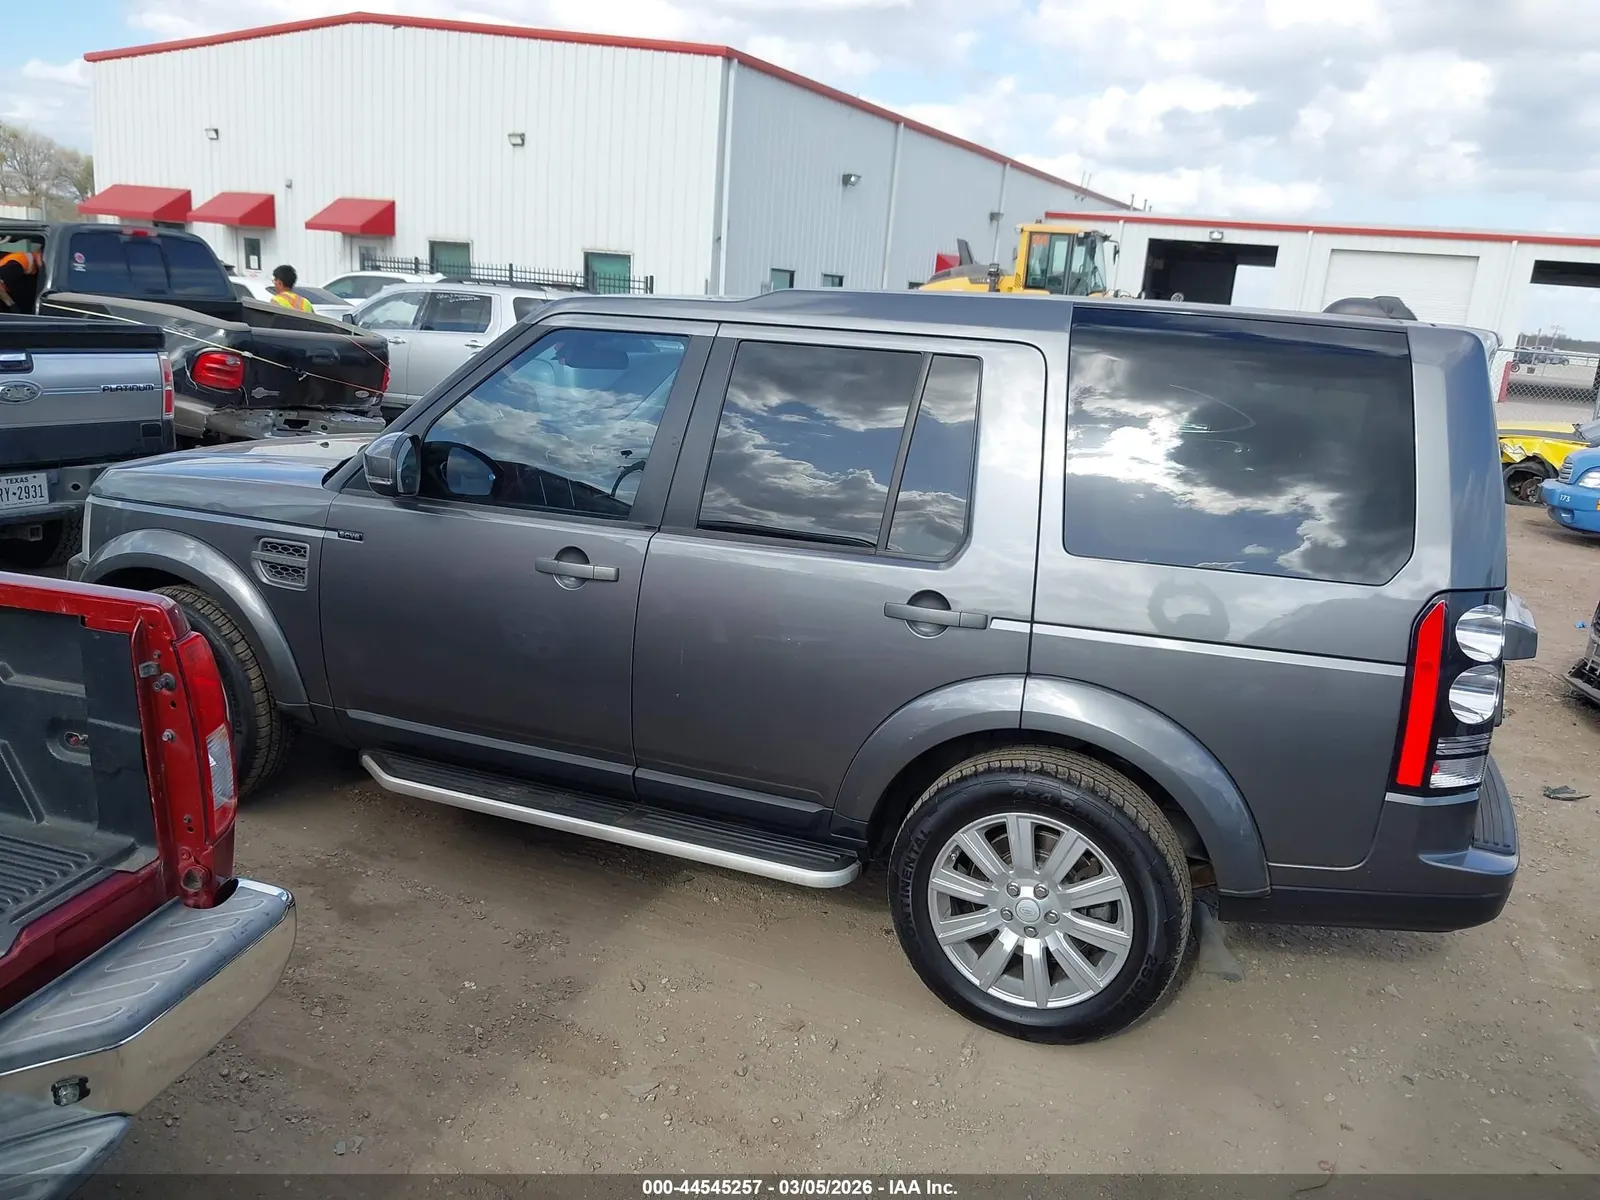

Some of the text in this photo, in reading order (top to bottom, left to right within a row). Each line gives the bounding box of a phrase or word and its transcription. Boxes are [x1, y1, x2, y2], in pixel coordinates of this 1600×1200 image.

[101, 383, 155, 393] PLATINUM
[5, 476, 29, 485] TEXAS
[1559, 494, 1571, 503] 173
